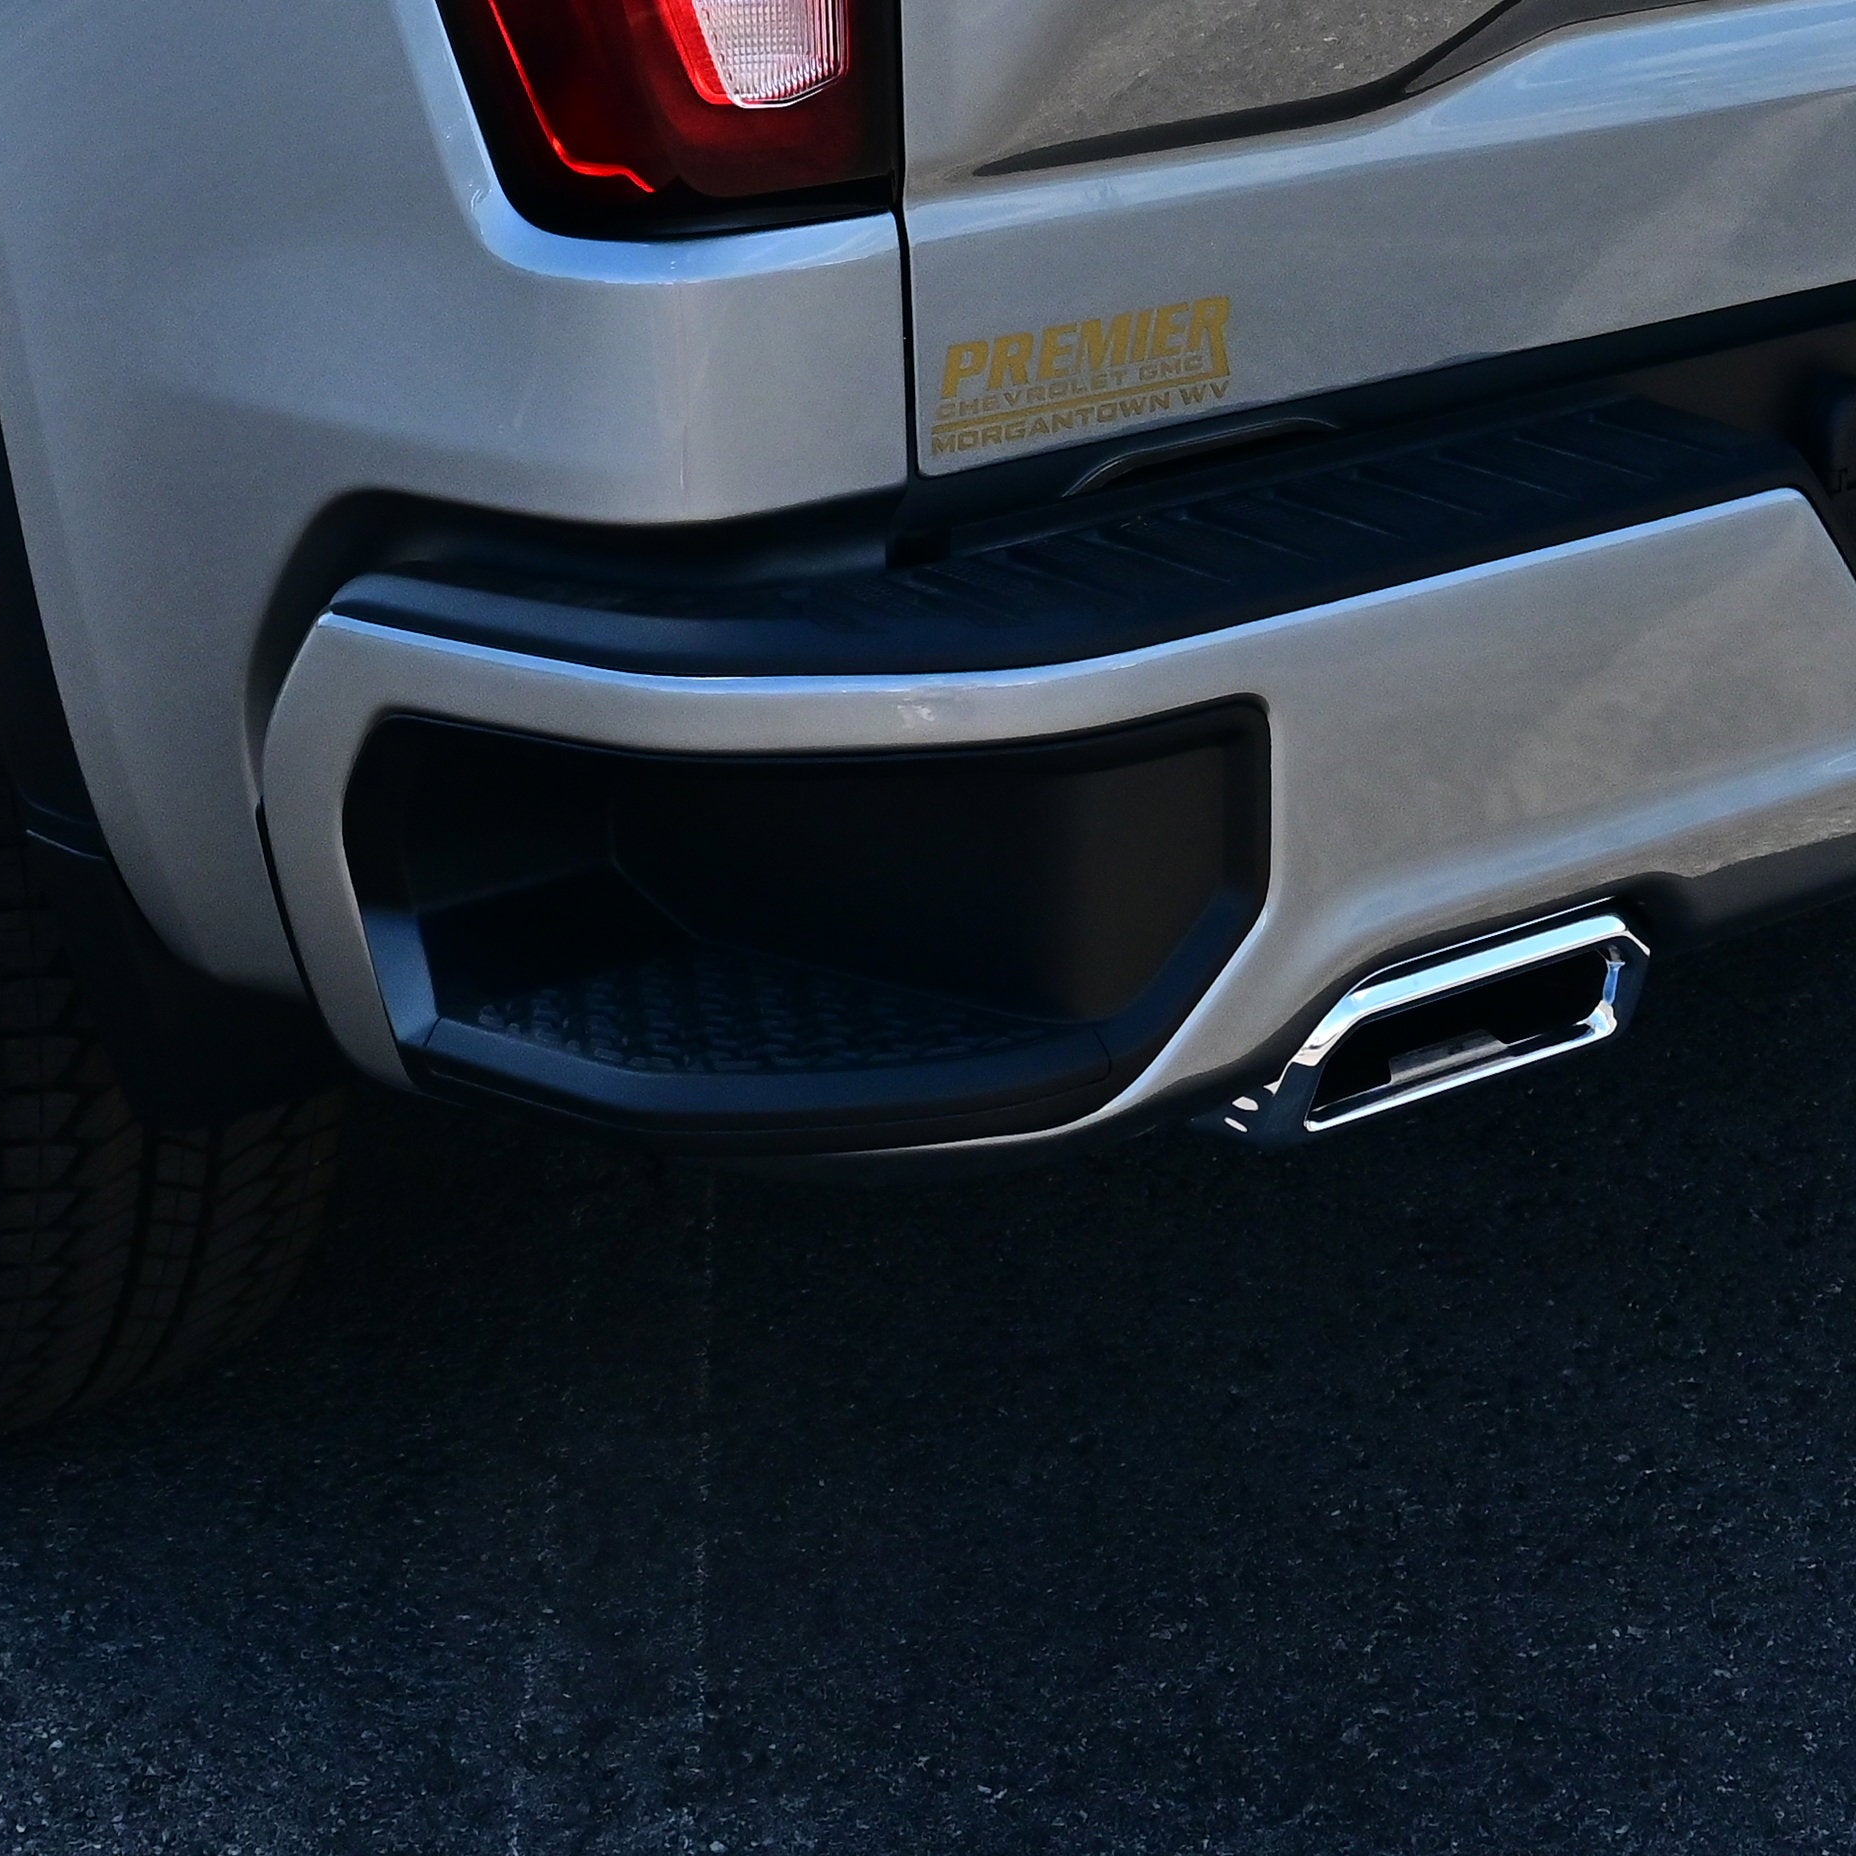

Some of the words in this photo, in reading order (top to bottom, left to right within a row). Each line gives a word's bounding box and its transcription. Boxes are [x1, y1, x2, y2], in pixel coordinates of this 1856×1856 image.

[941, 296, 1231, 398] PREMIER
[932, 390, 1172, 457] MORGANTOWN
[1178, 379, 1231, 408] WV
